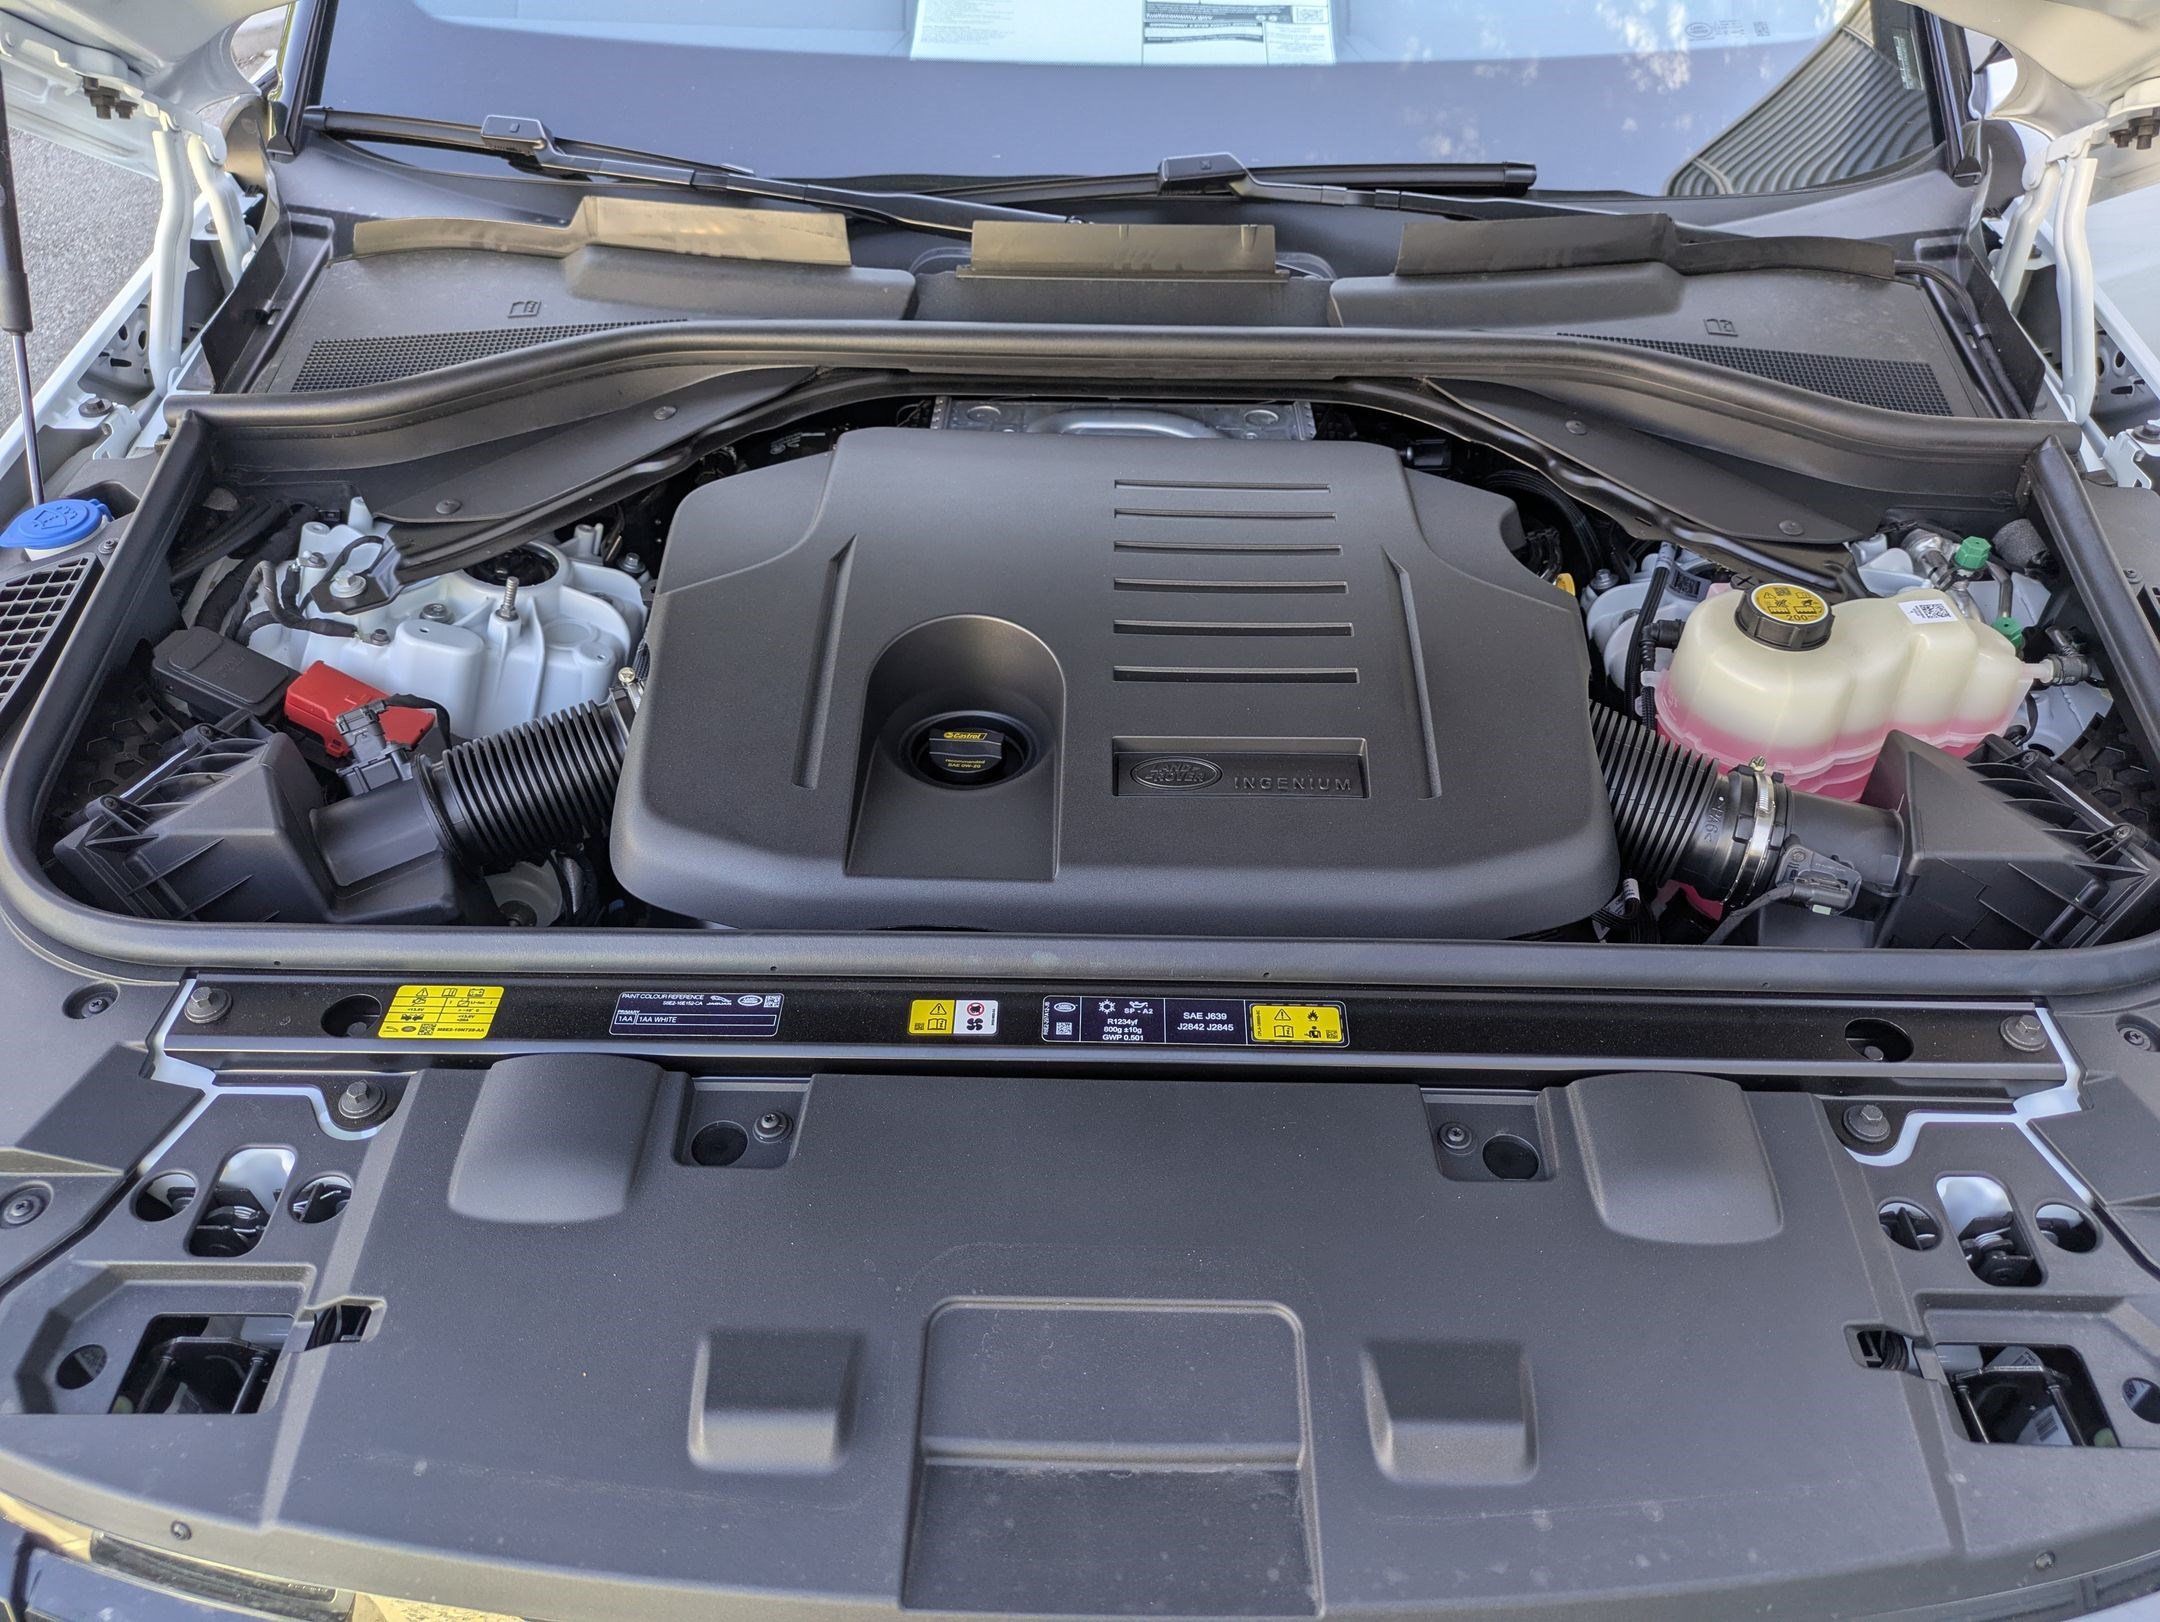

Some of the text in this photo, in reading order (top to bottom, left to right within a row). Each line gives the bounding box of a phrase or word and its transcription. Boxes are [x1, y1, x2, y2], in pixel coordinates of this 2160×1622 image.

[952, 732, 981, 740] Castrol
[1150, 763, 1192, 773] LAND
[1152, 772, 1204, 782] ROVER
[1233, 776, 1352, 792] INGENIUM
[1183, 1012, 1227, 1021] SAE J639
[1107, 1018, 1139, 1026] R1234yf
[1103, 1026, 1143, 1034] 800g ±10g
[1177, 1023, 1234, 1032] J2842 J2845
